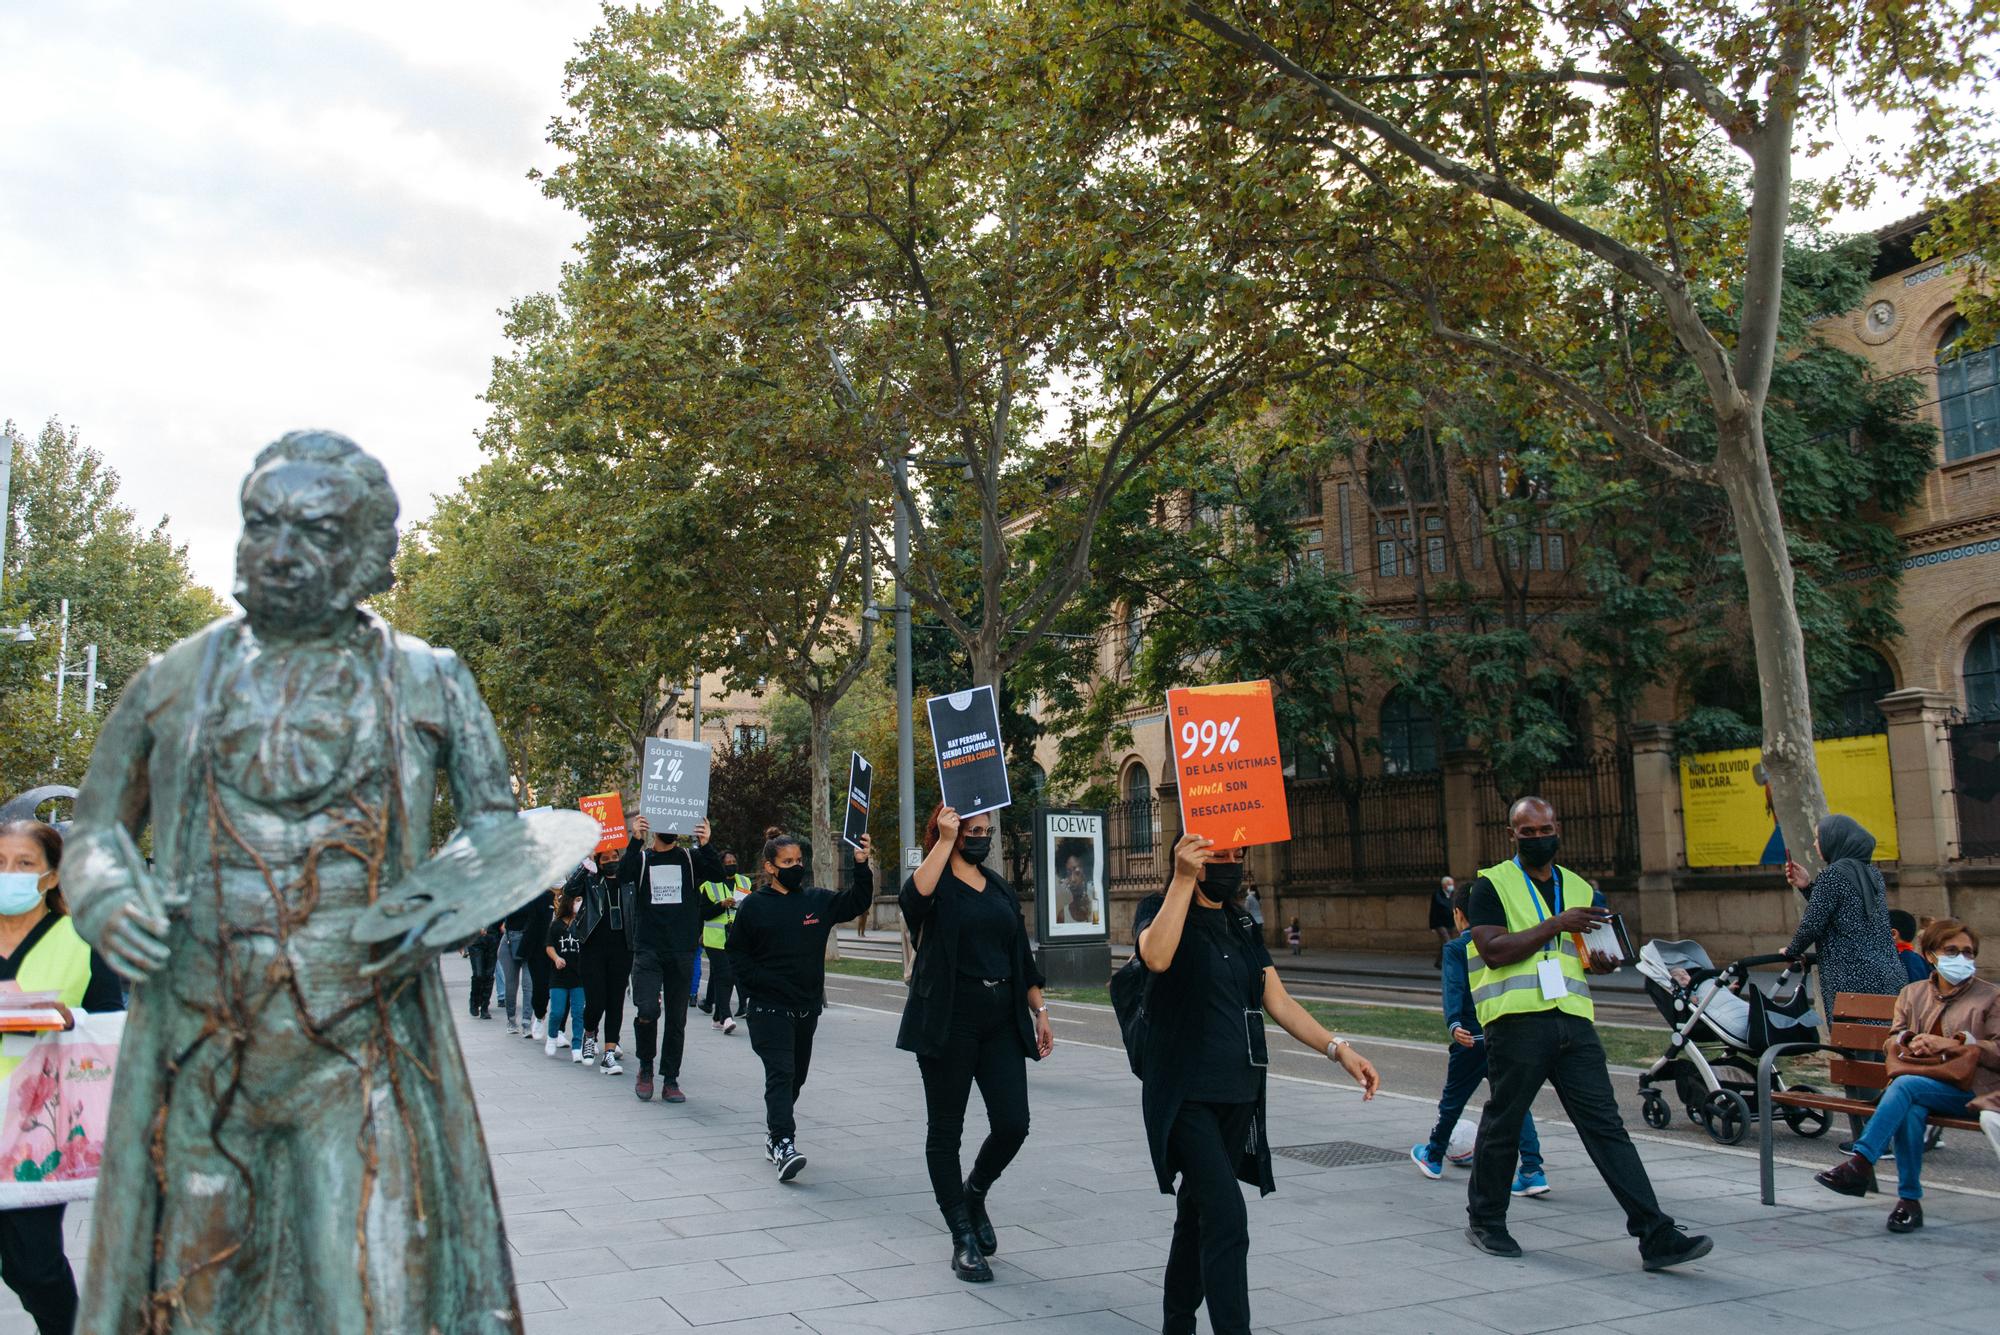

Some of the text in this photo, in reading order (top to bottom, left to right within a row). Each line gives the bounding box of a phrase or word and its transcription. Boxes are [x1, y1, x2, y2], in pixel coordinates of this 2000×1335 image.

[948, 732, 987, 748] HAY PERSONAS
[1181, 716, 1240, 759] 99%
[674, 750, 684, 758] EL
[942, 740, 995, 759] SIENDO EXPLOTADAS
[943, 749, 997, 769] EN NUESTRA CIUDAD.
[1186, 756, 1277, 776] DE LAS VÍCTIMAS
[1719, 760, 1750, 773] OLVIDO
[649, 757, 684, 783] 1%
[647, 782, 677, 792] DE LAS
[1189, 780, 1248, 797] NUNCA SON
[1690, 777, 1707, 789] UNA
[646, 794, 705, 807] VÍCTIMAS SON
[1191, 799, 1264, 817] RESCATADAS.
[646, 806, 702, 818] RESCATADAS.
[1051, 816, 1096, 833] LOEWE
